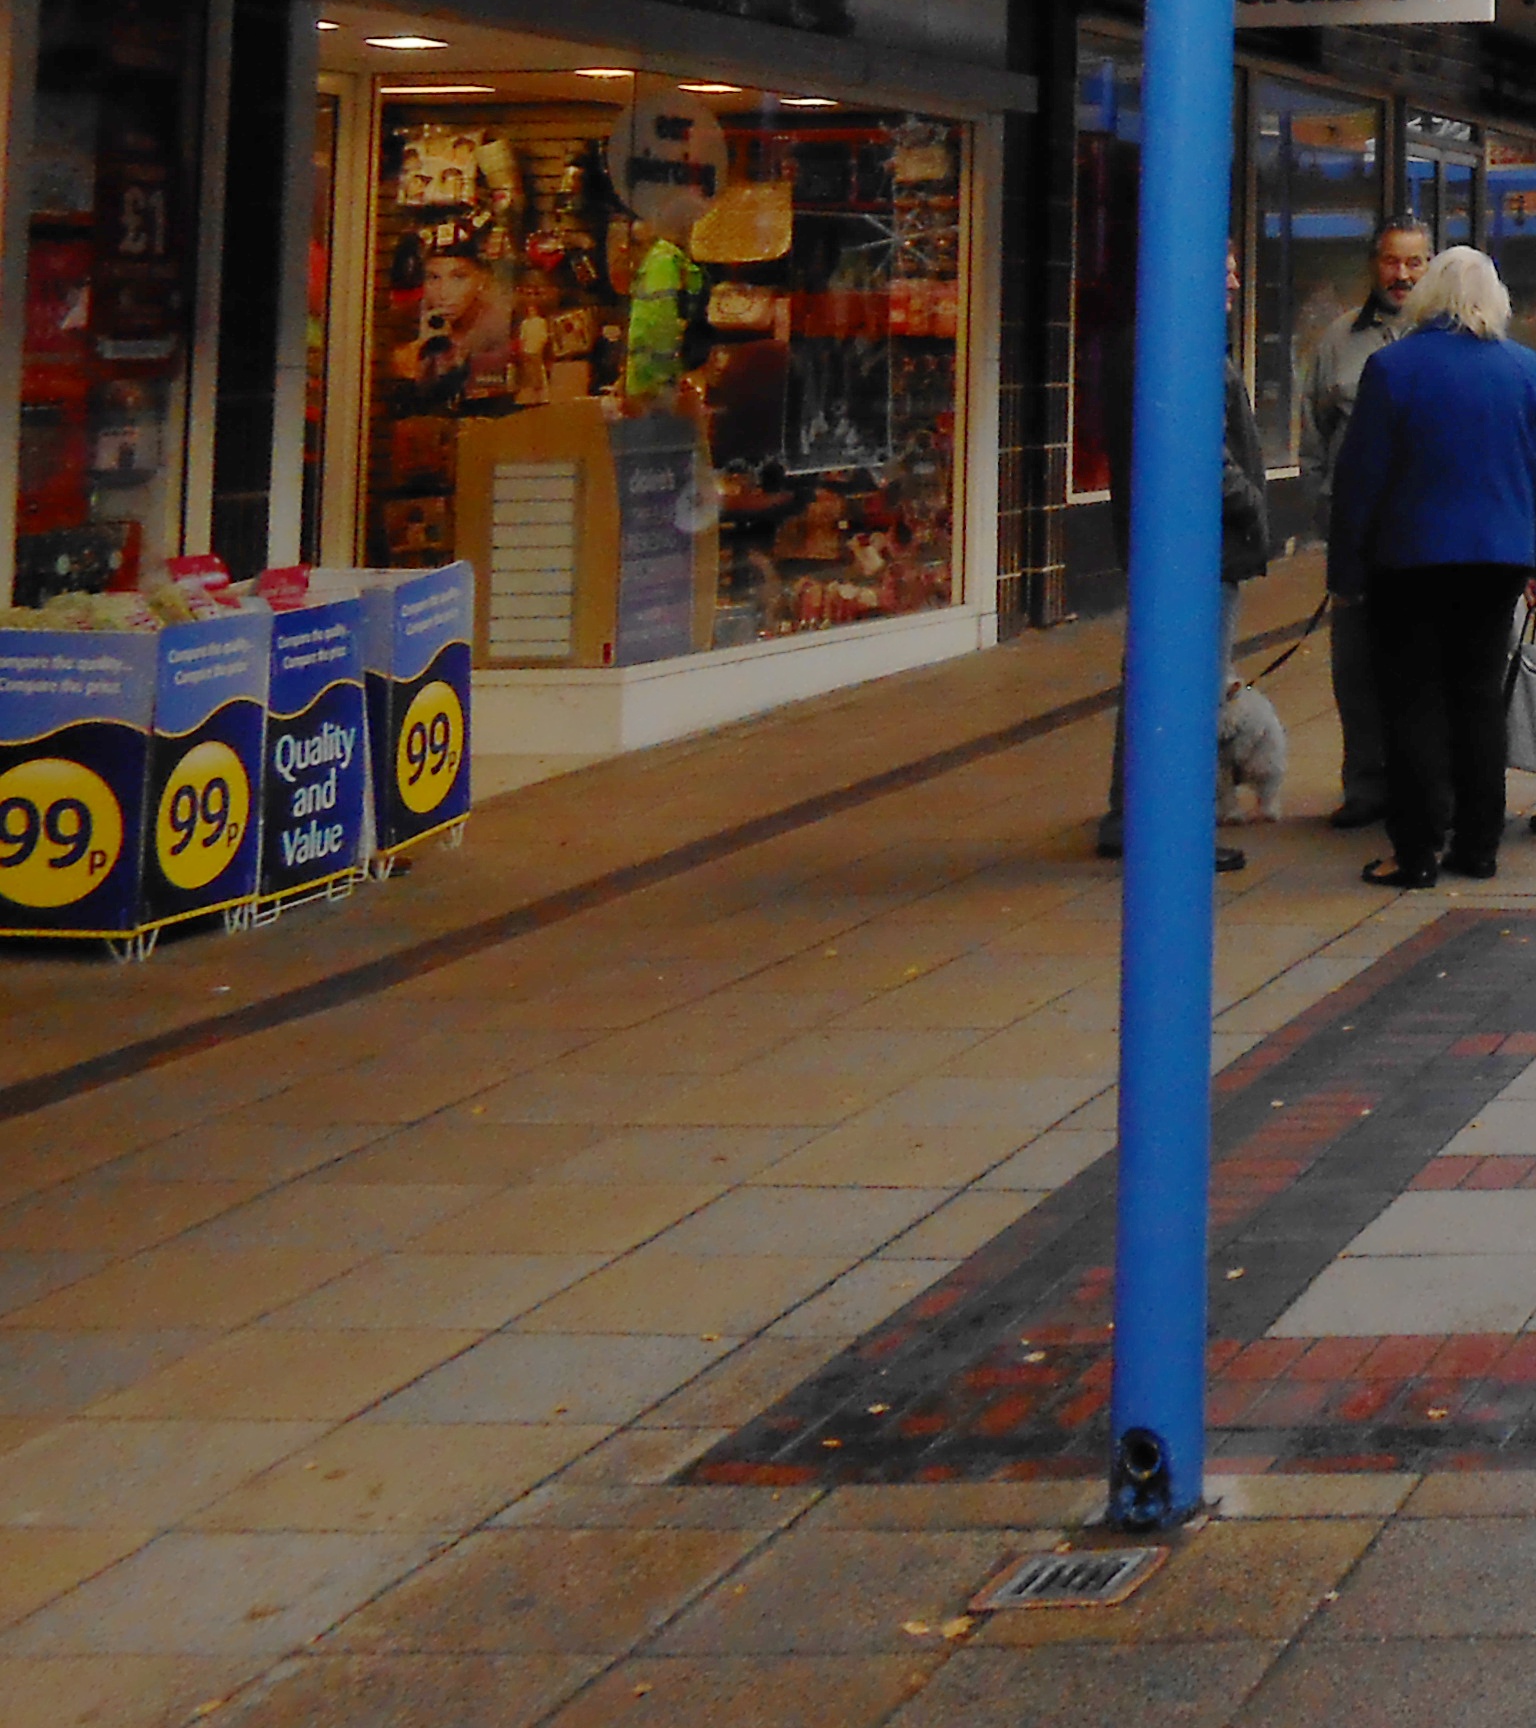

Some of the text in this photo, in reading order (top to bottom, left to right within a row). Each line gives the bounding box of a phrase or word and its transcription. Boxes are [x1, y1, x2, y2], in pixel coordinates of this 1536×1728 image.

[119, 187, 168, 255] £1
[275, 721, 356, 783] Quality
[292, 767, 337, 818] and
[282, 819, 344, 867] Value
